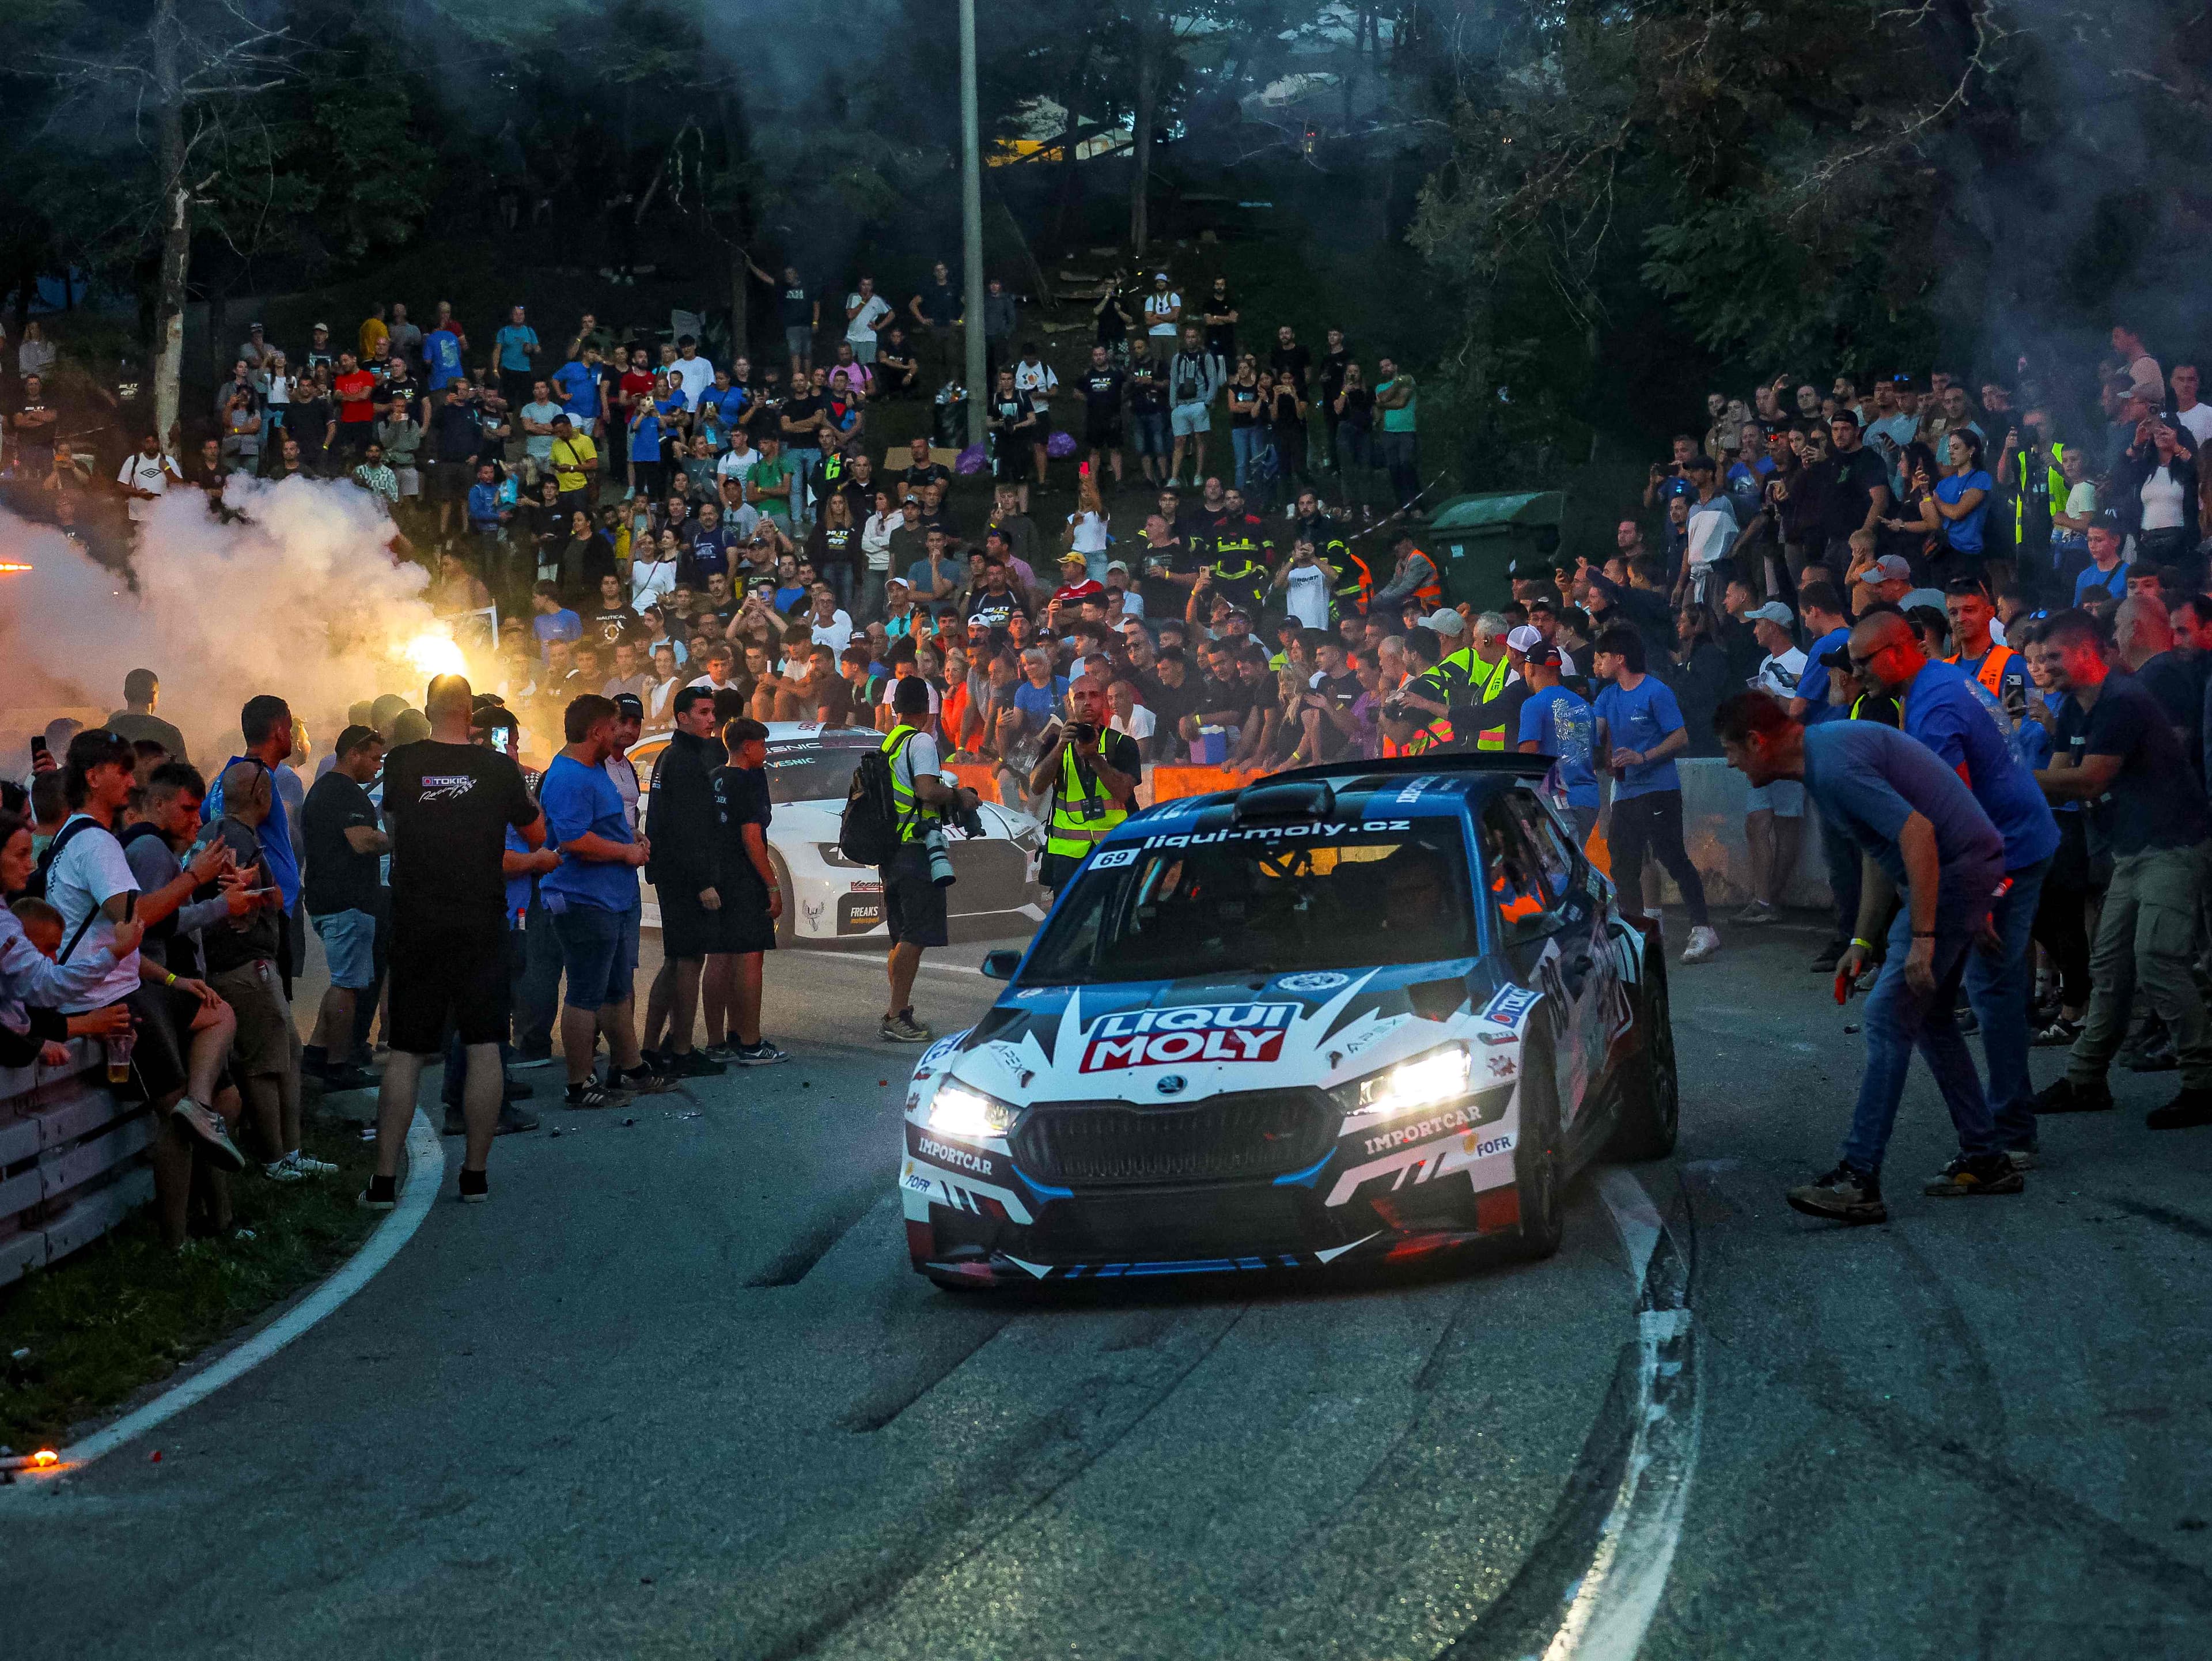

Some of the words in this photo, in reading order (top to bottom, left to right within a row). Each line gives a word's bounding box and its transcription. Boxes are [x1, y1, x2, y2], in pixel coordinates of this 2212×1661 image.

[767, 758, 816, 768] VESNIC
[1143, 820, 1410, 849] liqui-moly.cz
[1100, 852, 1129, 867] 69
[851, 906, 878, 917] FREAKS
[1101, 1006, 1288, 1037] LIQUI
[1089, 1028, 1283, 1070] MOLY
[1365, 1106, 1482, 1155] IMPORTCAR
[919, 1137, 993, 1175] IMPORTCAR
[1477, 1136, 1512, 1156] FOFR
